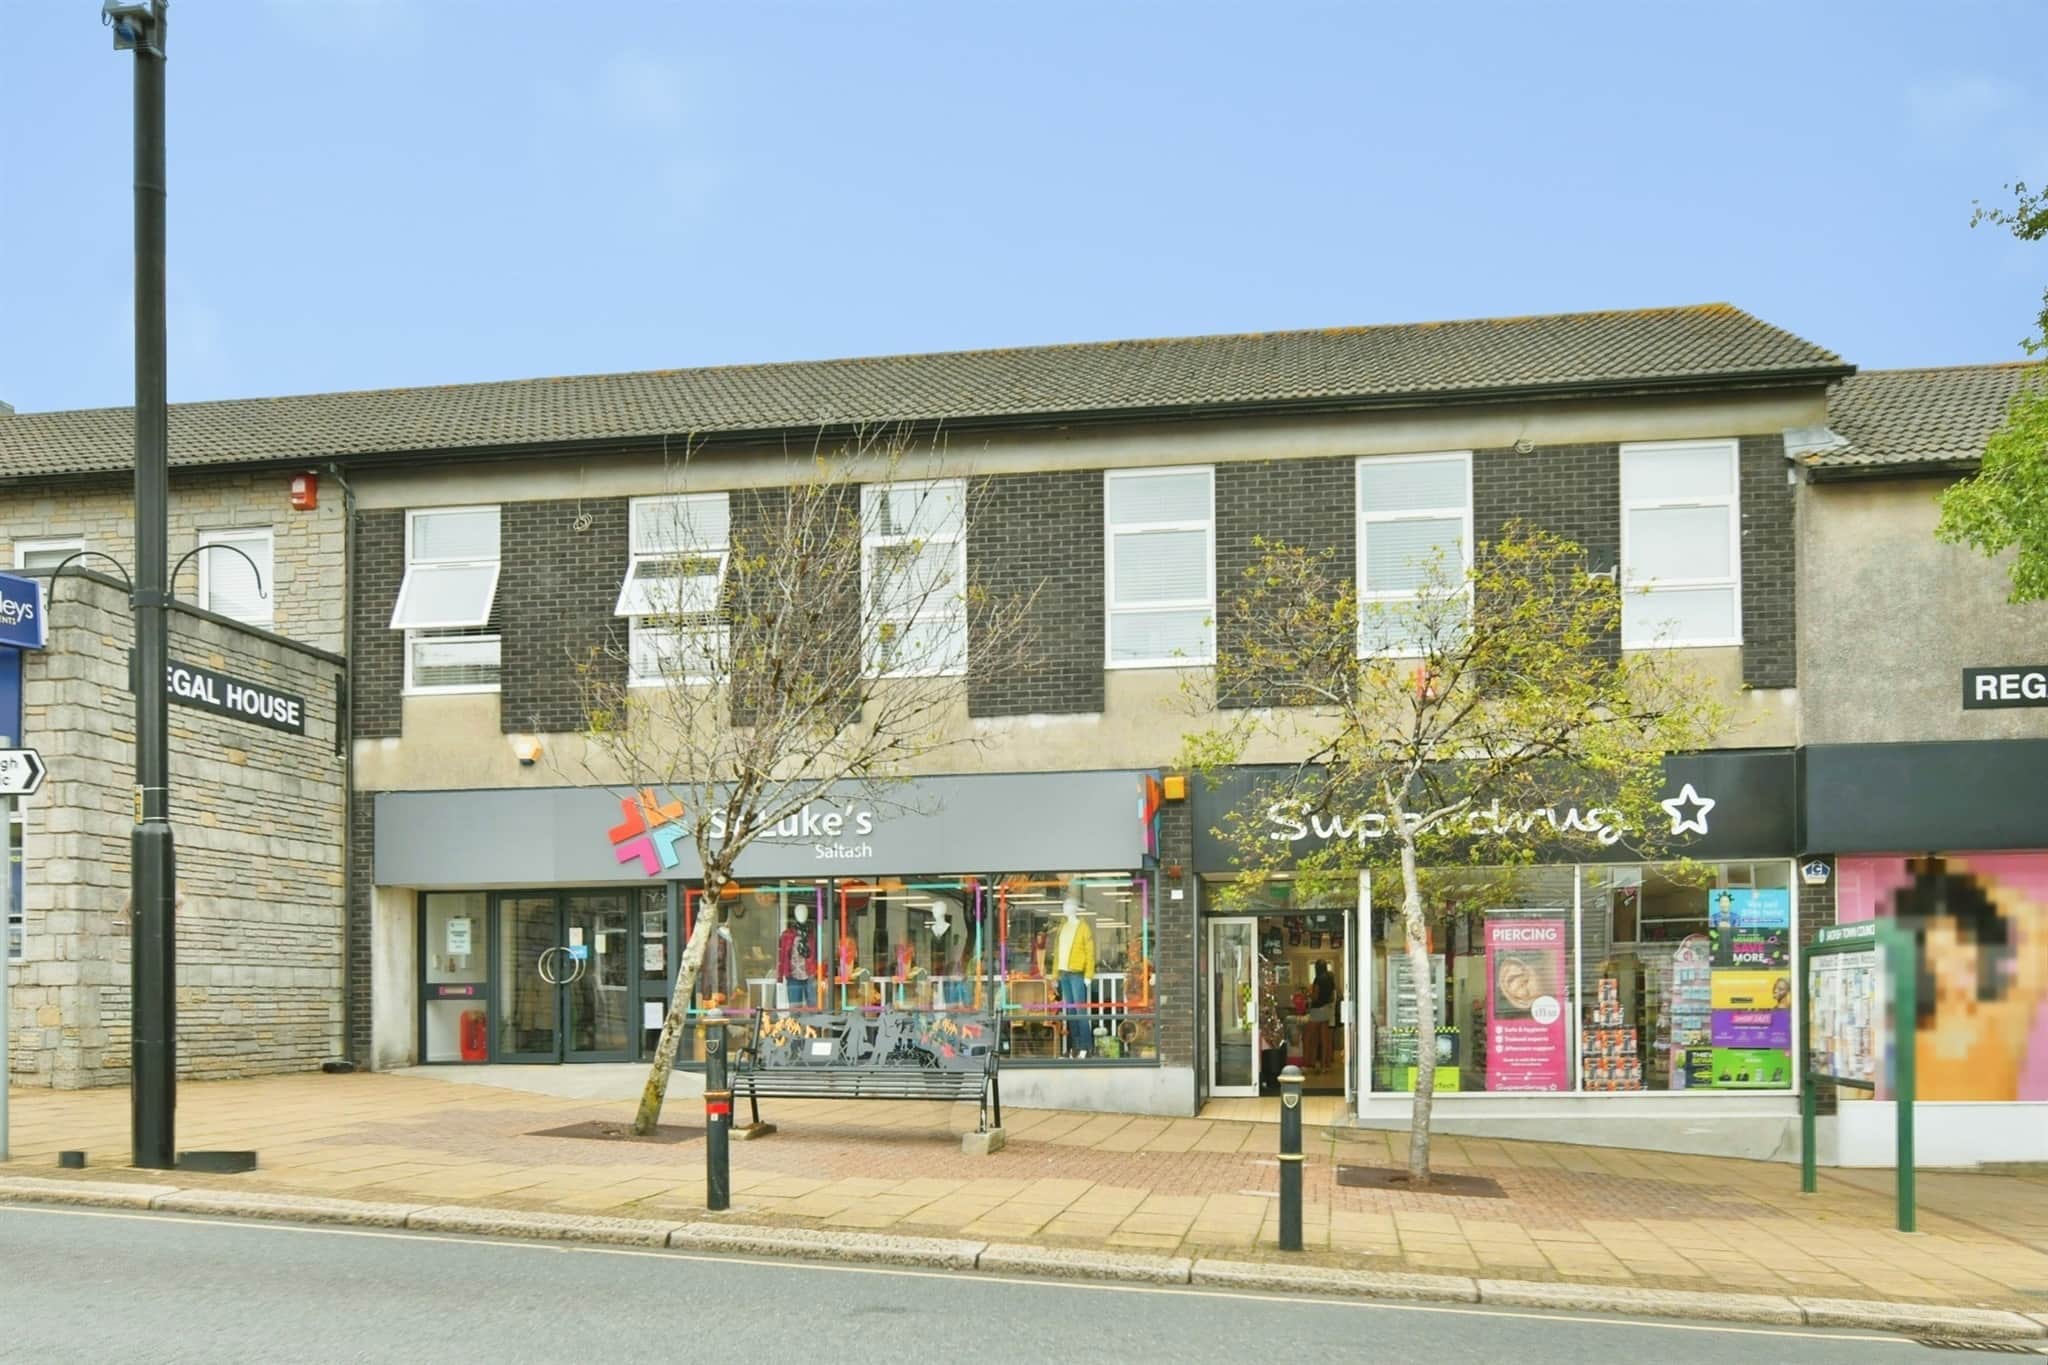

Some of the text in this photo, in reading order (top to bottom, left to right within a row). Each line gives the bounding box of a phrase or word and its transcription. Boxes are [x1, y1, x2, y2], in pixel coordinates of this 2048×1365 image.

[167, 666, 300, 726] GAL HOUSE
[815, 842, 873, 859] Saltash
[1492, 928, 1557, 941] PIERCING
[1733, 953, 1765, 962] MORE
